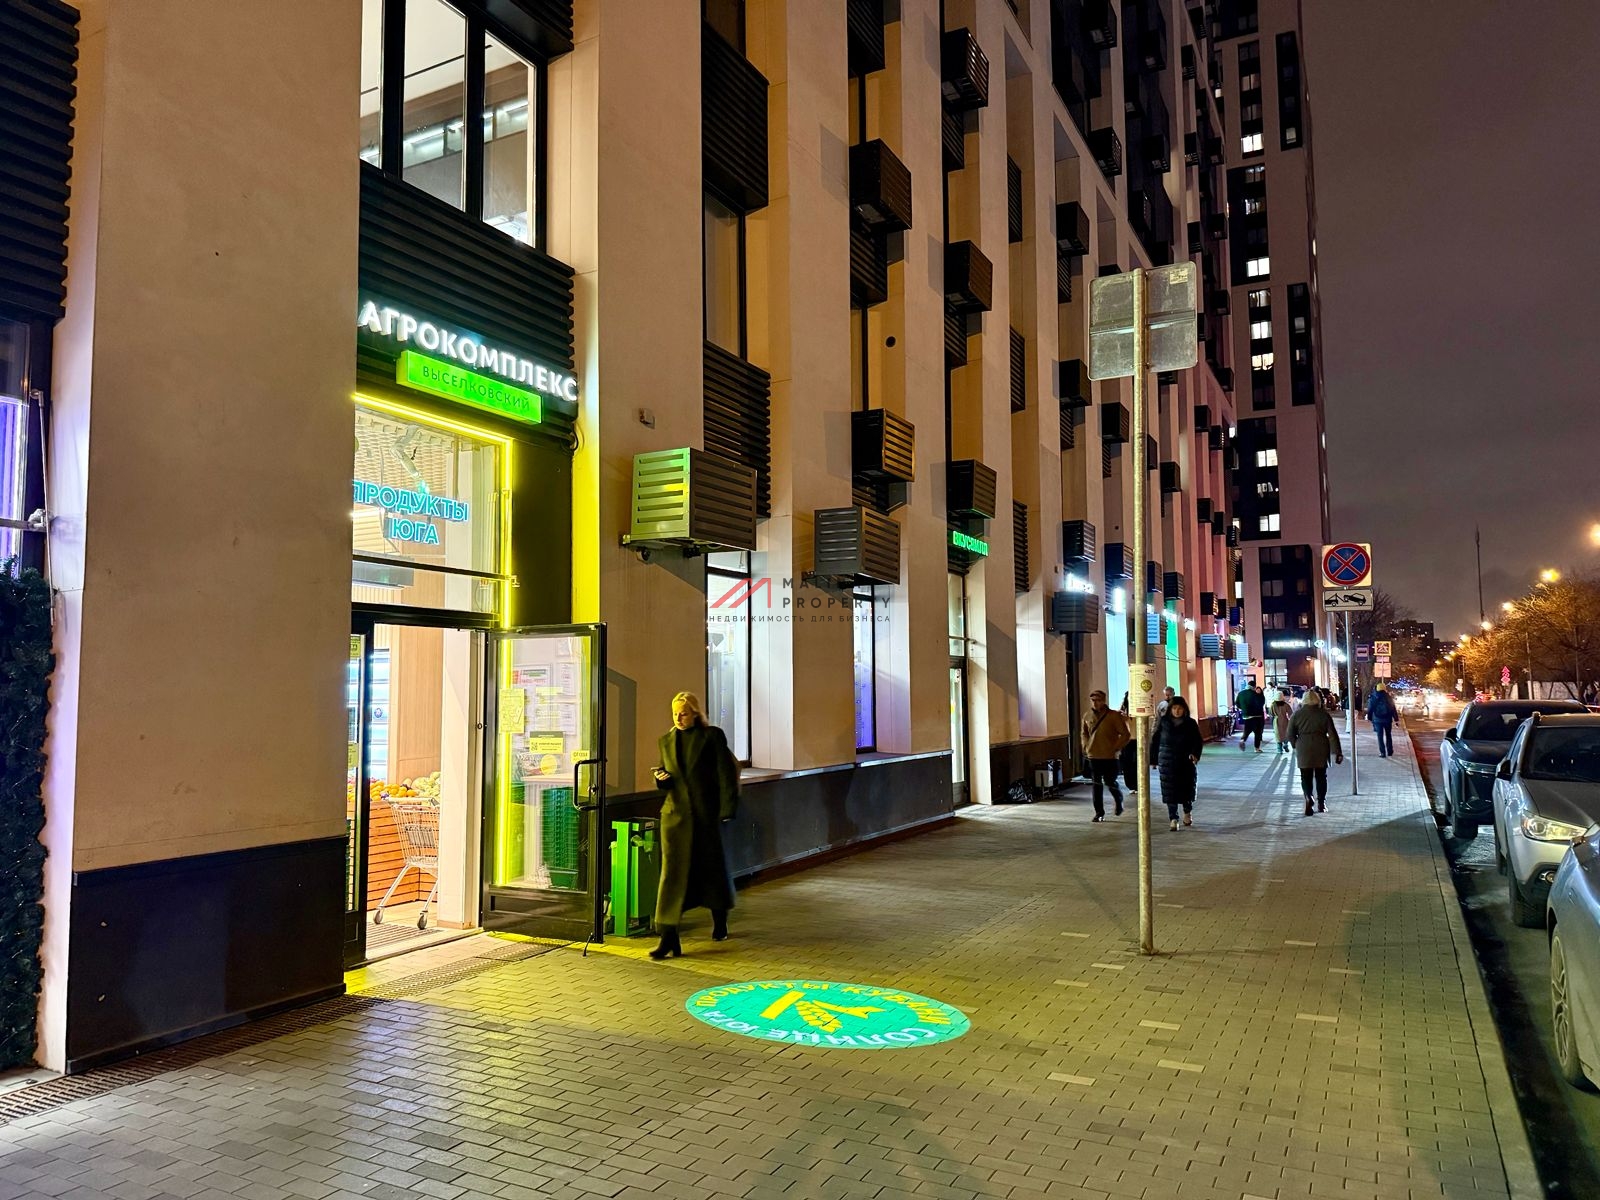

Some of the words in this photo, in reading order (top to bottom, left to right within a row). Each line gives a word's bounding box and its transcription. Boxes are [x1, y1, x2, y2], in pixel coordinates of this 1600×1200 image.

[358, 301, 577, 401] АГРОКОМПЛЕКС
[422, 365, 530, 411] ВЫСЕЛКОВСКИЙ
[353, 481, 469, 522] ПРОДУКТЫ
[391, 518, 440, 545] ЮГА
[696, 982, 829, 1007] ПРОДУКТЫ
[842, 986, 951, 1025] КУБАНИ
[703, 1010, 759, 1031] ЮГА
[766, 1027, 936, 1046] СОЛНЦЕ
